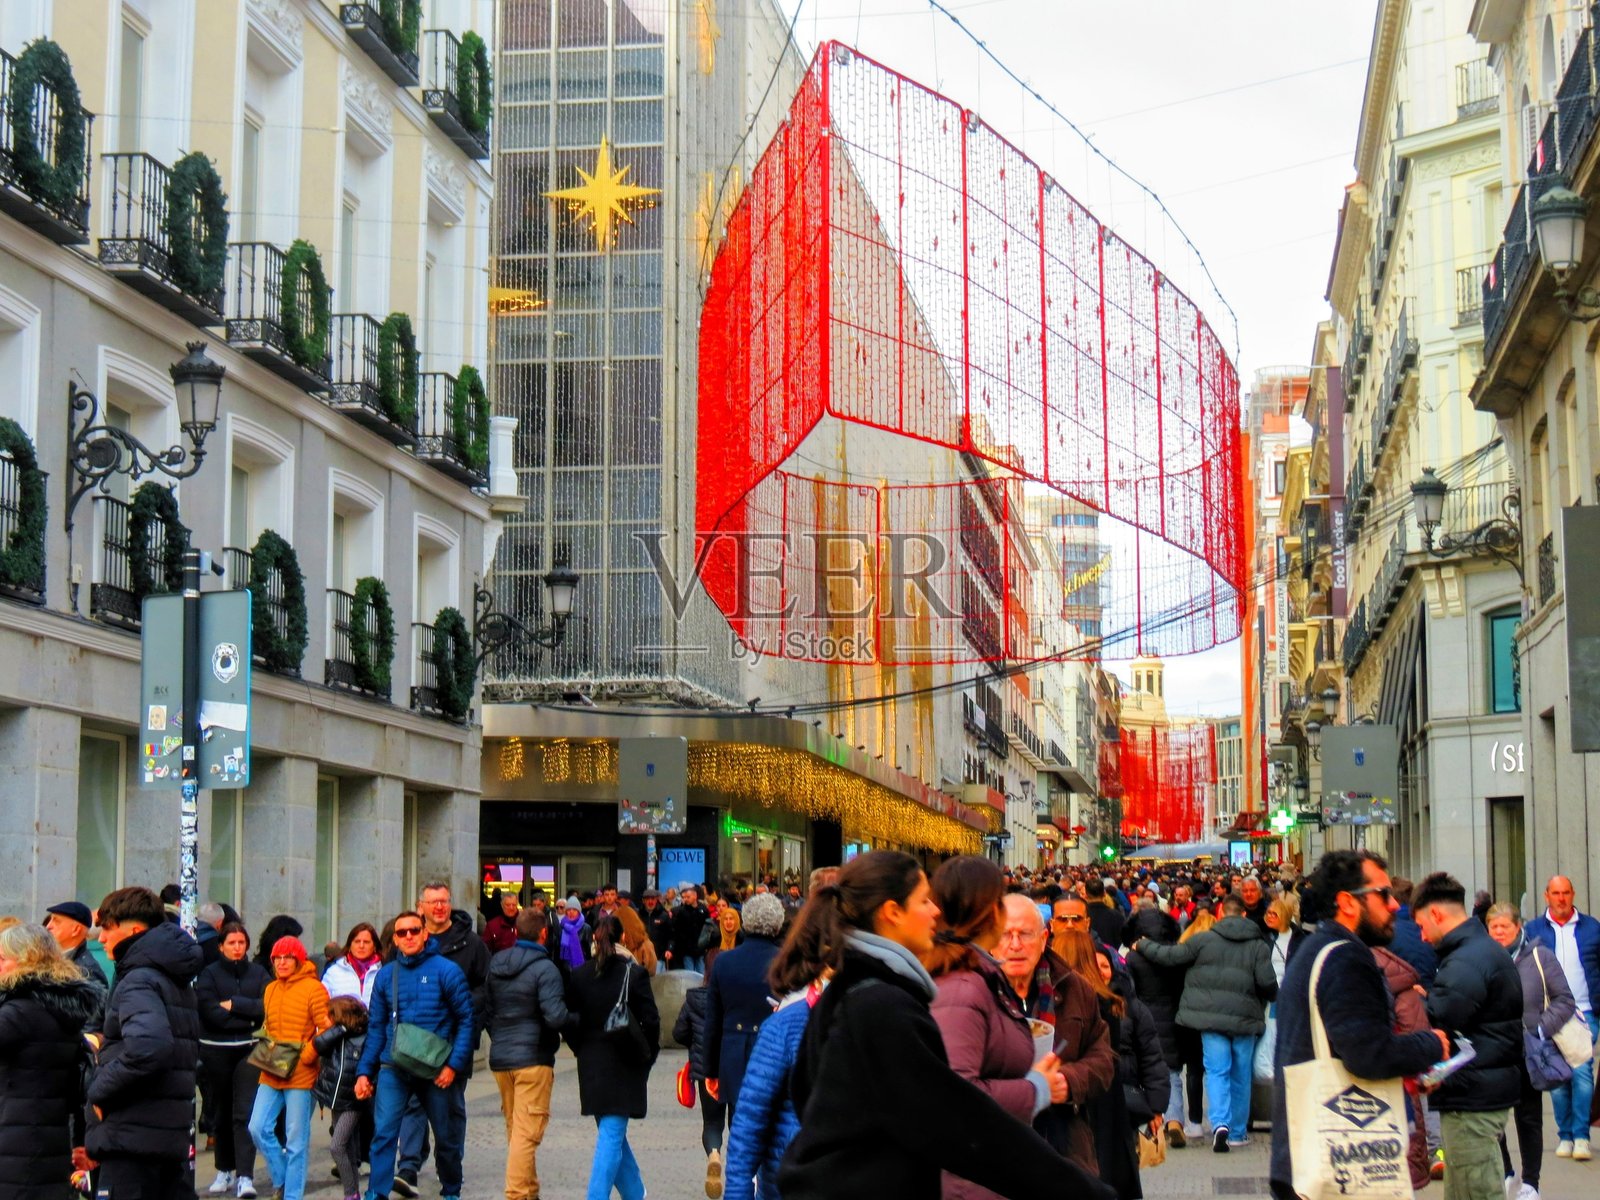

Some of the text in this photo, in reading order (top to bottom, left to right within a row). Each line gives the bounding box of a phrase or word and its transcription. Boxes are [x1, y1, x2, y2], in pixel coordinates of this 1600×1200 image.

[1332, 510, 1346, 589] Foot Locker
[660, 850, 704, 863] LOEWE
[1329, 1138, 1402, 1168] MADRID
